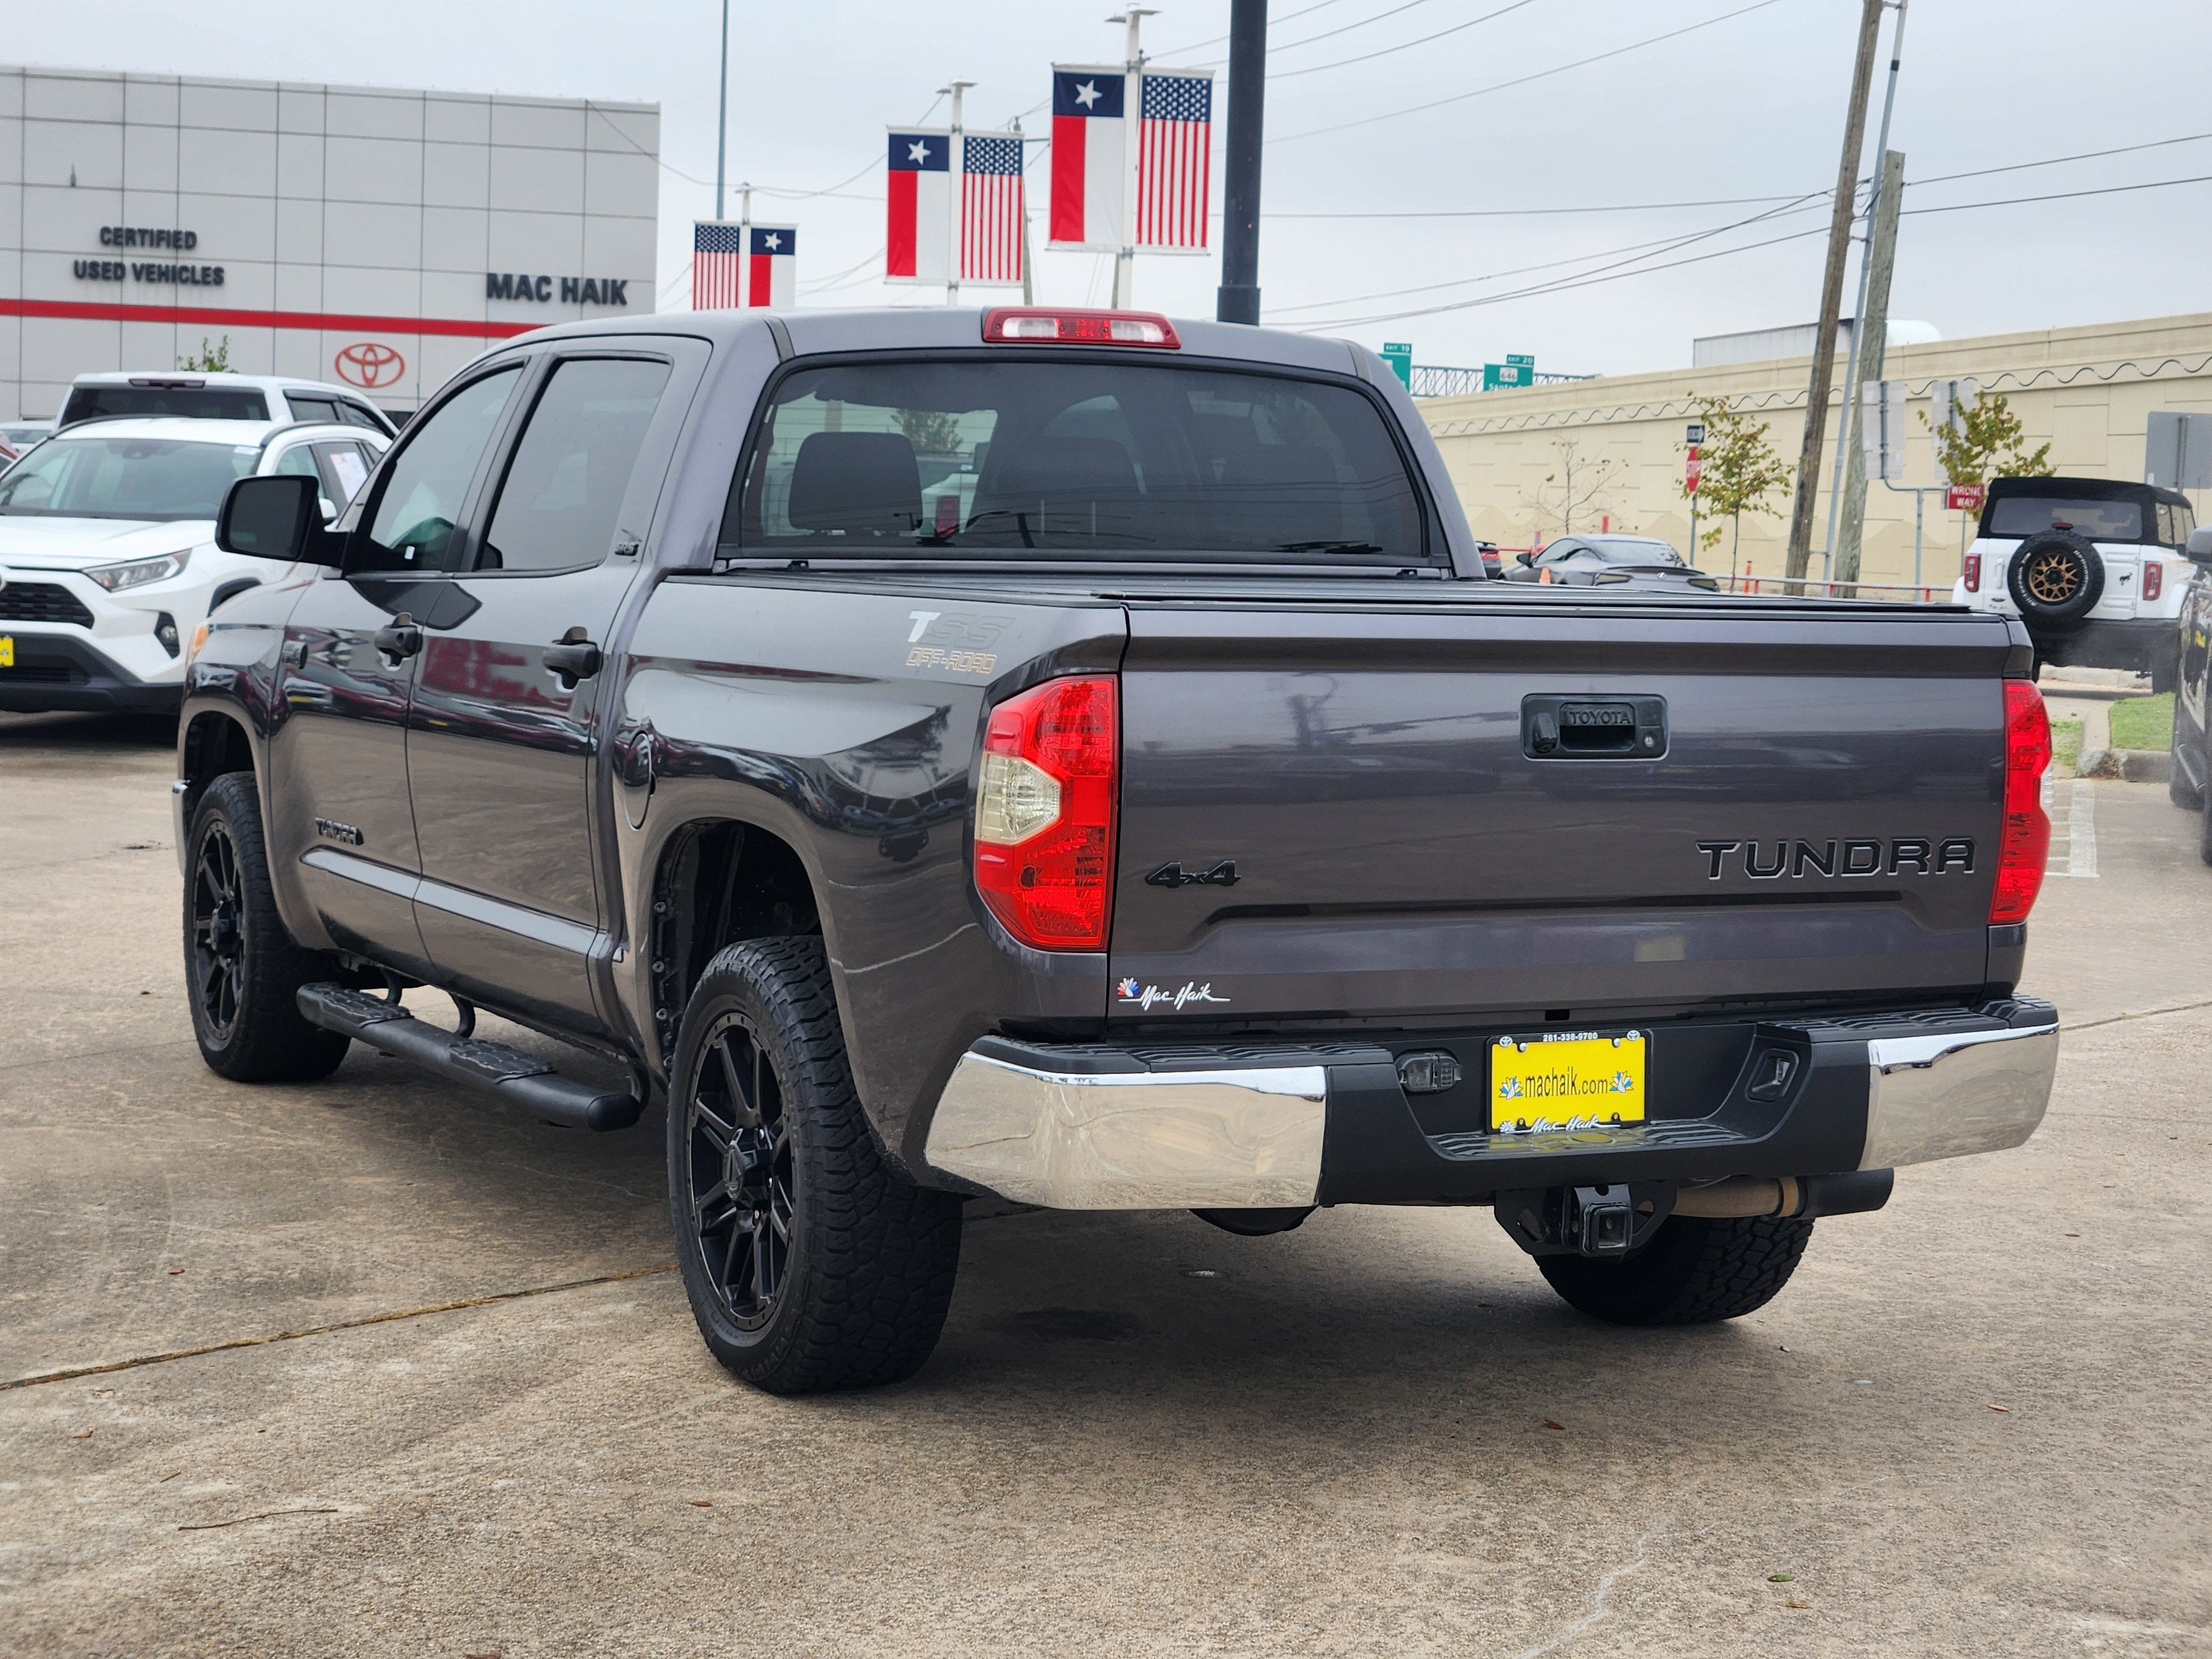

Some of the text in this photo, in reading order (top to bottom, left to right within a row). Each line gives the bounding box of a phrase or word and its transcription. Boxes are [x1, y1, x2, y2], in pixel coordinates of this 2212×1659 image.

[100, 226, 197, 250] CERTIFIED
[74, 260, 225, 286] USED VEHICLES
[486, 273, 628, 306] MAC HAIK
[1501, 372, 1516, 380] 646
[1957, 497, 1976, 507] WAY
[907, 610, 1016, 649] TSS
[905, 646, 997, 675] OFF-ROAD
[1569, 709, 1631, 724] TOYOTA
[1696, 837, 1976, 880] TUNDRA
[1145, 860, 1242, 888] 4x4
[1136, 981, 1220, 1011] Mac Haik
[1542, 1032, 1599, 1042] 281-338-9700
[1524, 1066, 1609, 1098] machaik.com
[1530, 1114, 1608, 1134] Mac Haik
